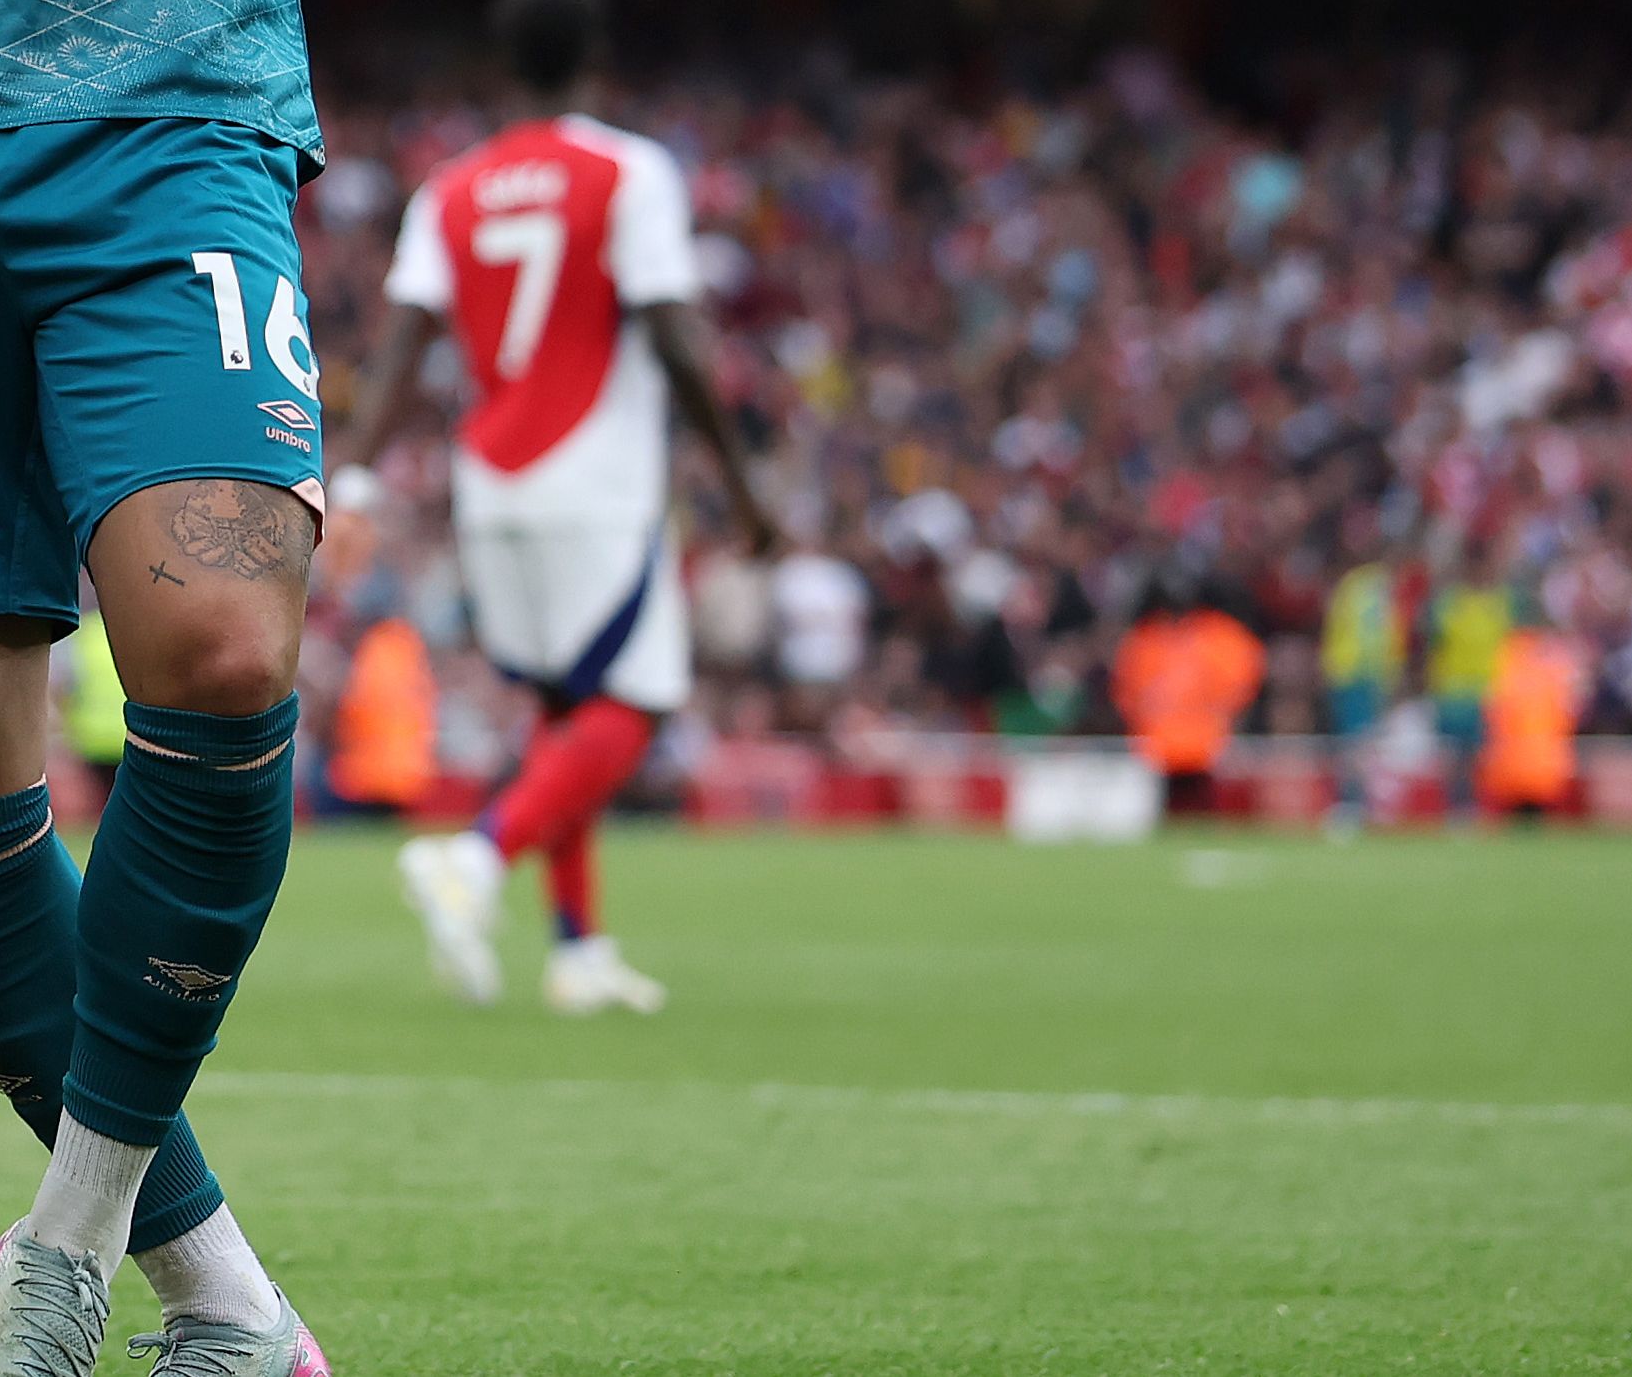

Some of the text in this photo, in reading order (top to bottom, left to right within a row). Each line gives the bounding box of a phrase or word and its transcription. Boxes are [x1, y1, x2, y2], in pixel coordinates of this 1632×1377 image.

[191, 252, 320, 401] 16
[470, 210, 569, 382] 7
[265, 426, 312, 453] umbro
